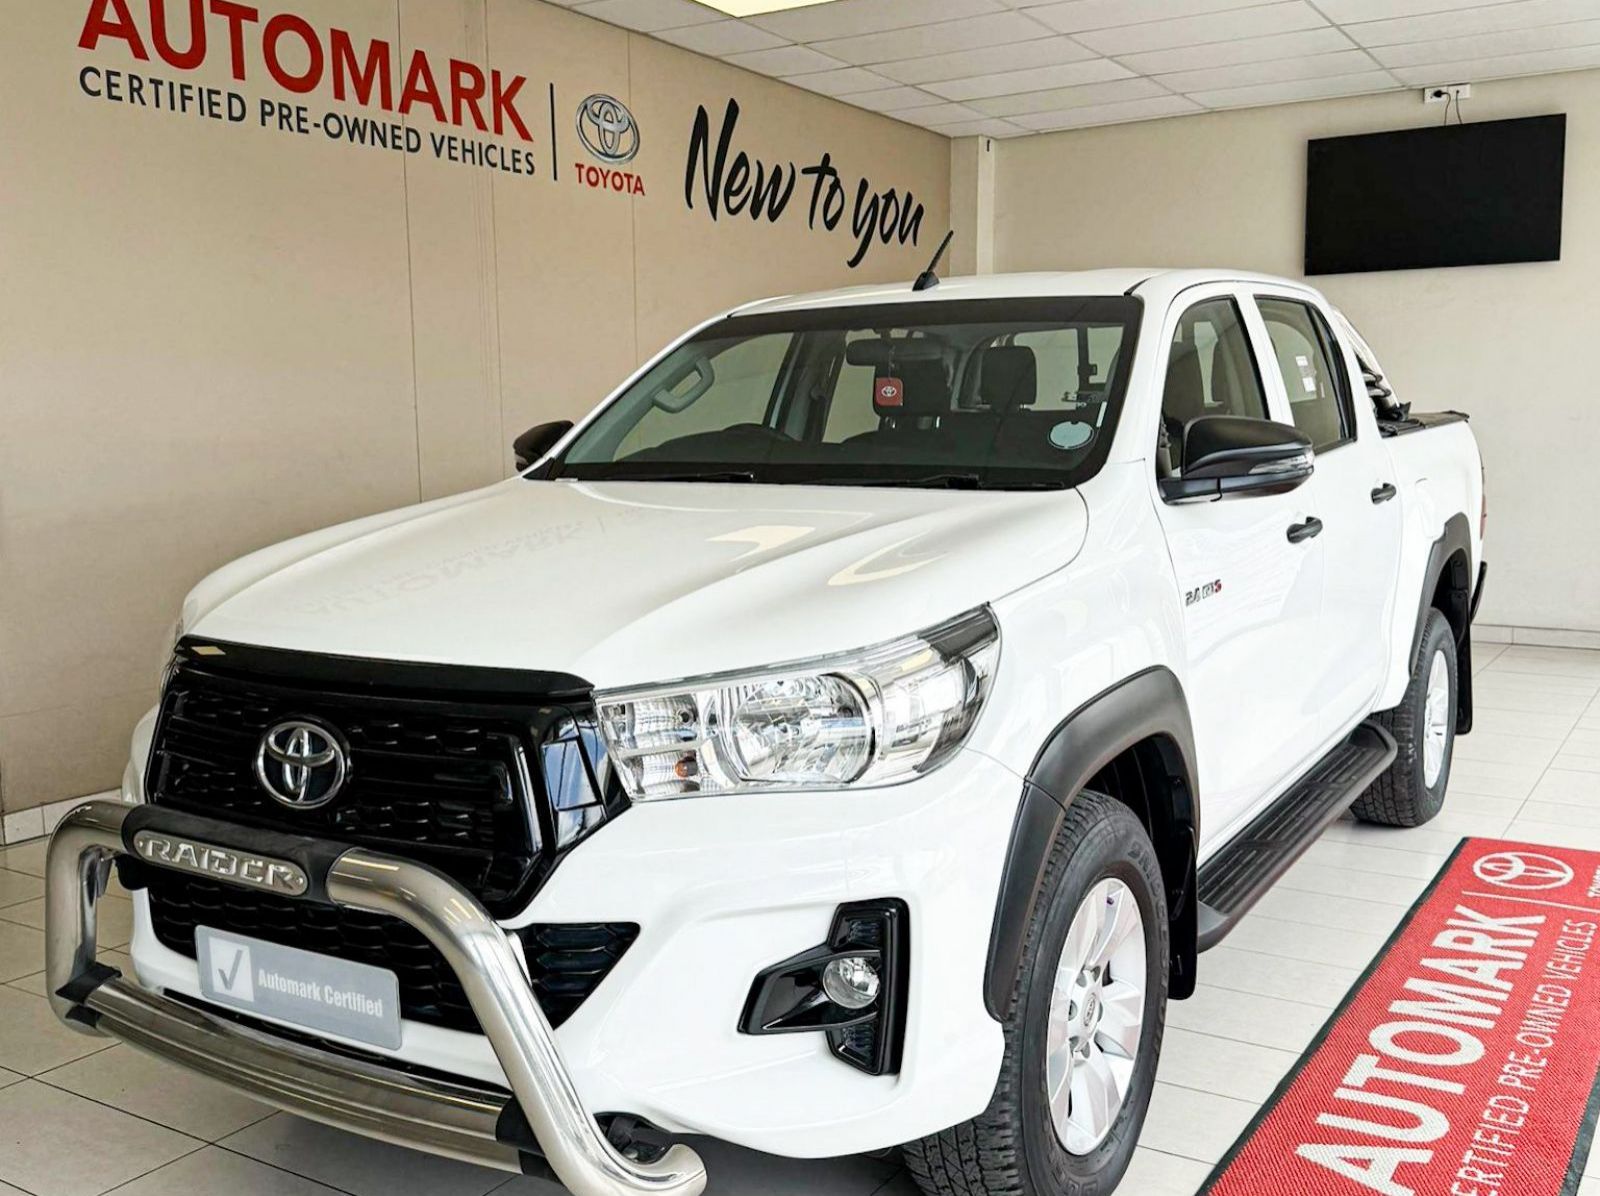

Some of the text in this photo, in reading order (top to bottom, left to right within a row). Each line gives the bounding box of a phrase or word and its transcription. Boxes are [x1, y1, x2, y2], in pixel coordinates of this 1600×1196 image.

[78, 0, 533, 141] AUTOMARK
[79, 66, 535, 176] CERTIFIED PRE-OWNED VEHICLES
[575, 163, 645, 196] TOYOTA
[684, 97, 925, 268] New to you
[146, 837, 296, 891] RAIDER
[258, 968, 384, 1018] Automark Certified
[1294, 904, 1546, 1196] AUTOMARK
[1450, 919, 1598, 1196] ERTIFIED PRE-OWNED VEHICLES
